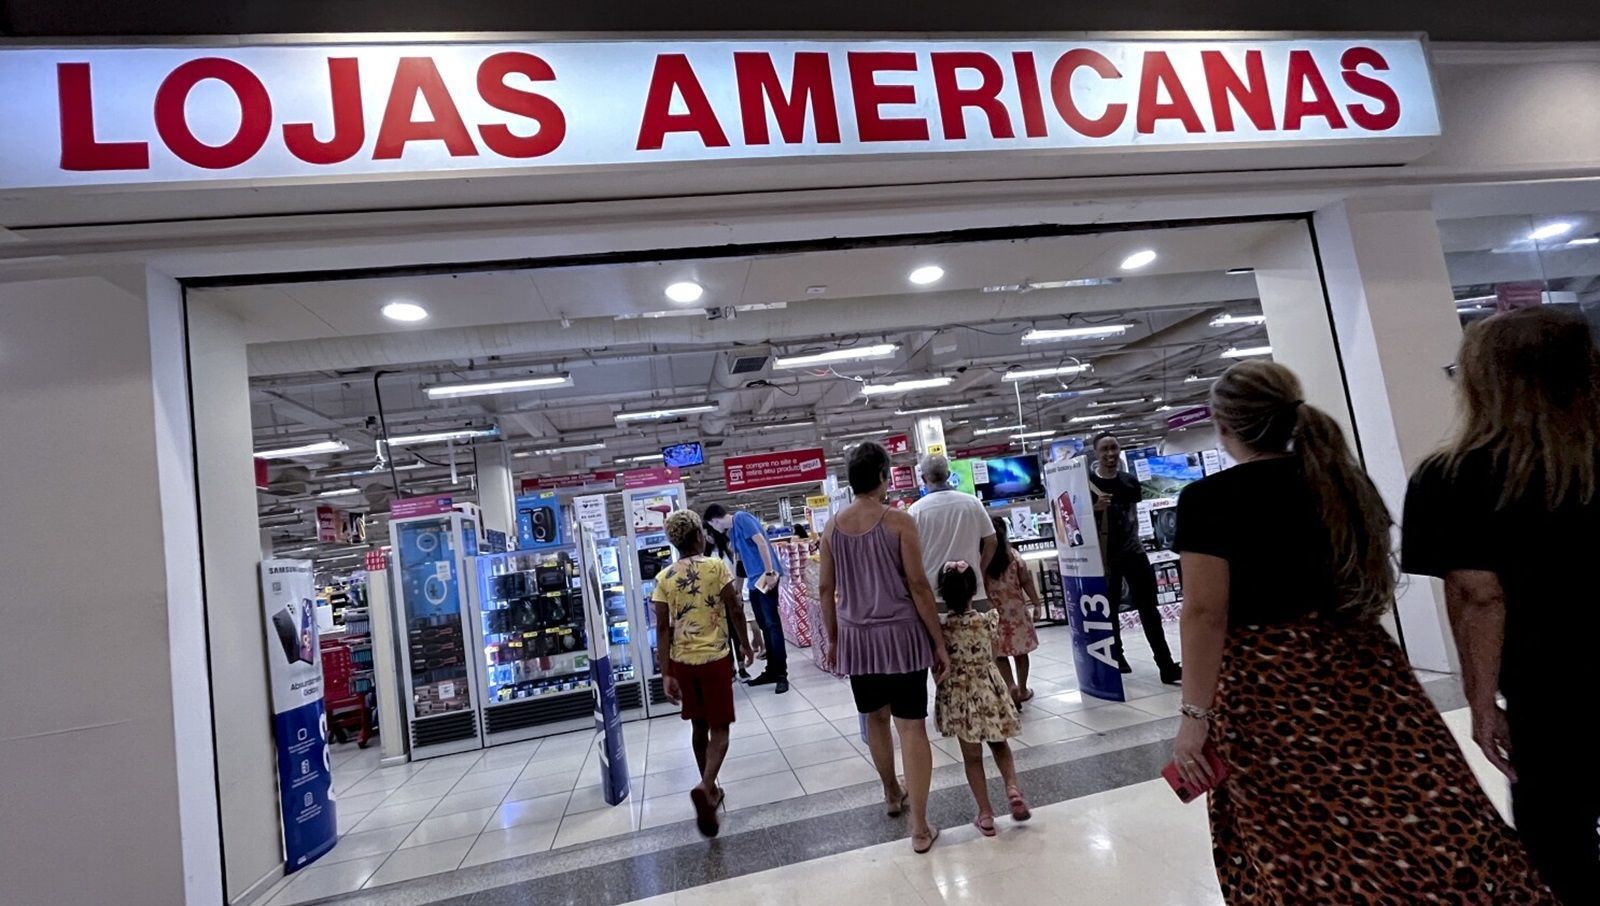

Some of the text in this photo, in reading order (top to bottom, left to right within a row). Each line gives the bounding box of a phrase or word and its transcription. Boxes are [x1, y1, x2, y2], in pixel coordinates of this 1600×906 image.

[57, 47, 1401, 171] LOJAS AMERICANAS
[745, 461, 770, 470] compre
[746, 460, 820, 476] retire seu produto aqui!
[1018, 541, 1055, 552] SAMSUNG
[1080, 594, 1120, 669] A13
